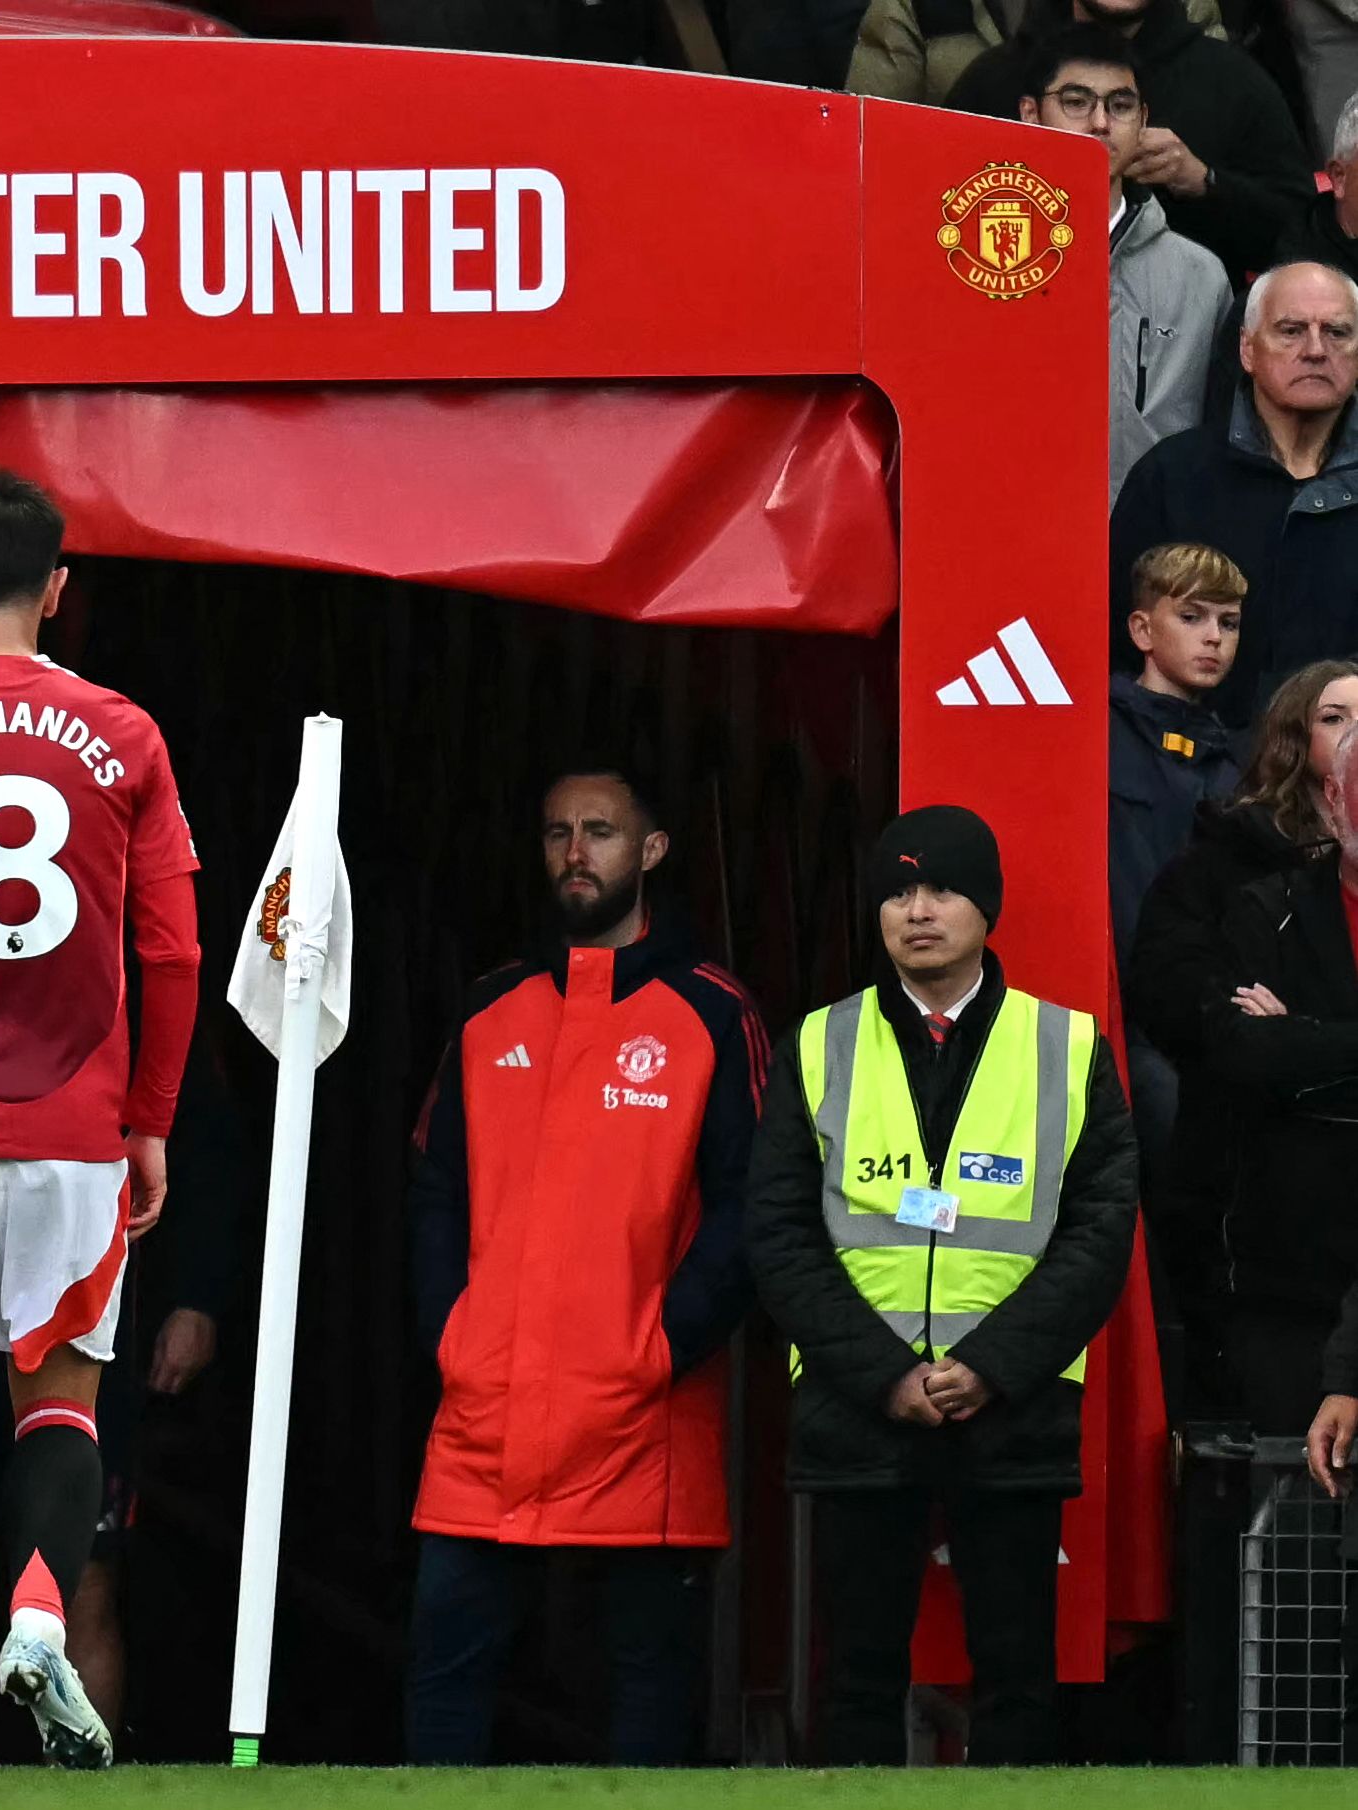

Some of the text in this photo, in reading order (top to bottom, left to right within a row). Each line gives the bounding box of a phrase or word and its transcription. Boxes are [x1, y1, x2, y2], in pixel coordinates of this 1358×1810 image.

[951, 171, 1059, 215] MANCHESTER
[179, 167, 567, 318] UNITED
[968, 266, 1044, 290] UNITED
[265, 874, 291, 933] MANCH
[622, 1088, 669, 1109] Tezos
[857, 1153, 912, 1183] 341
[987, 1168, 1023, 1184] CSG
